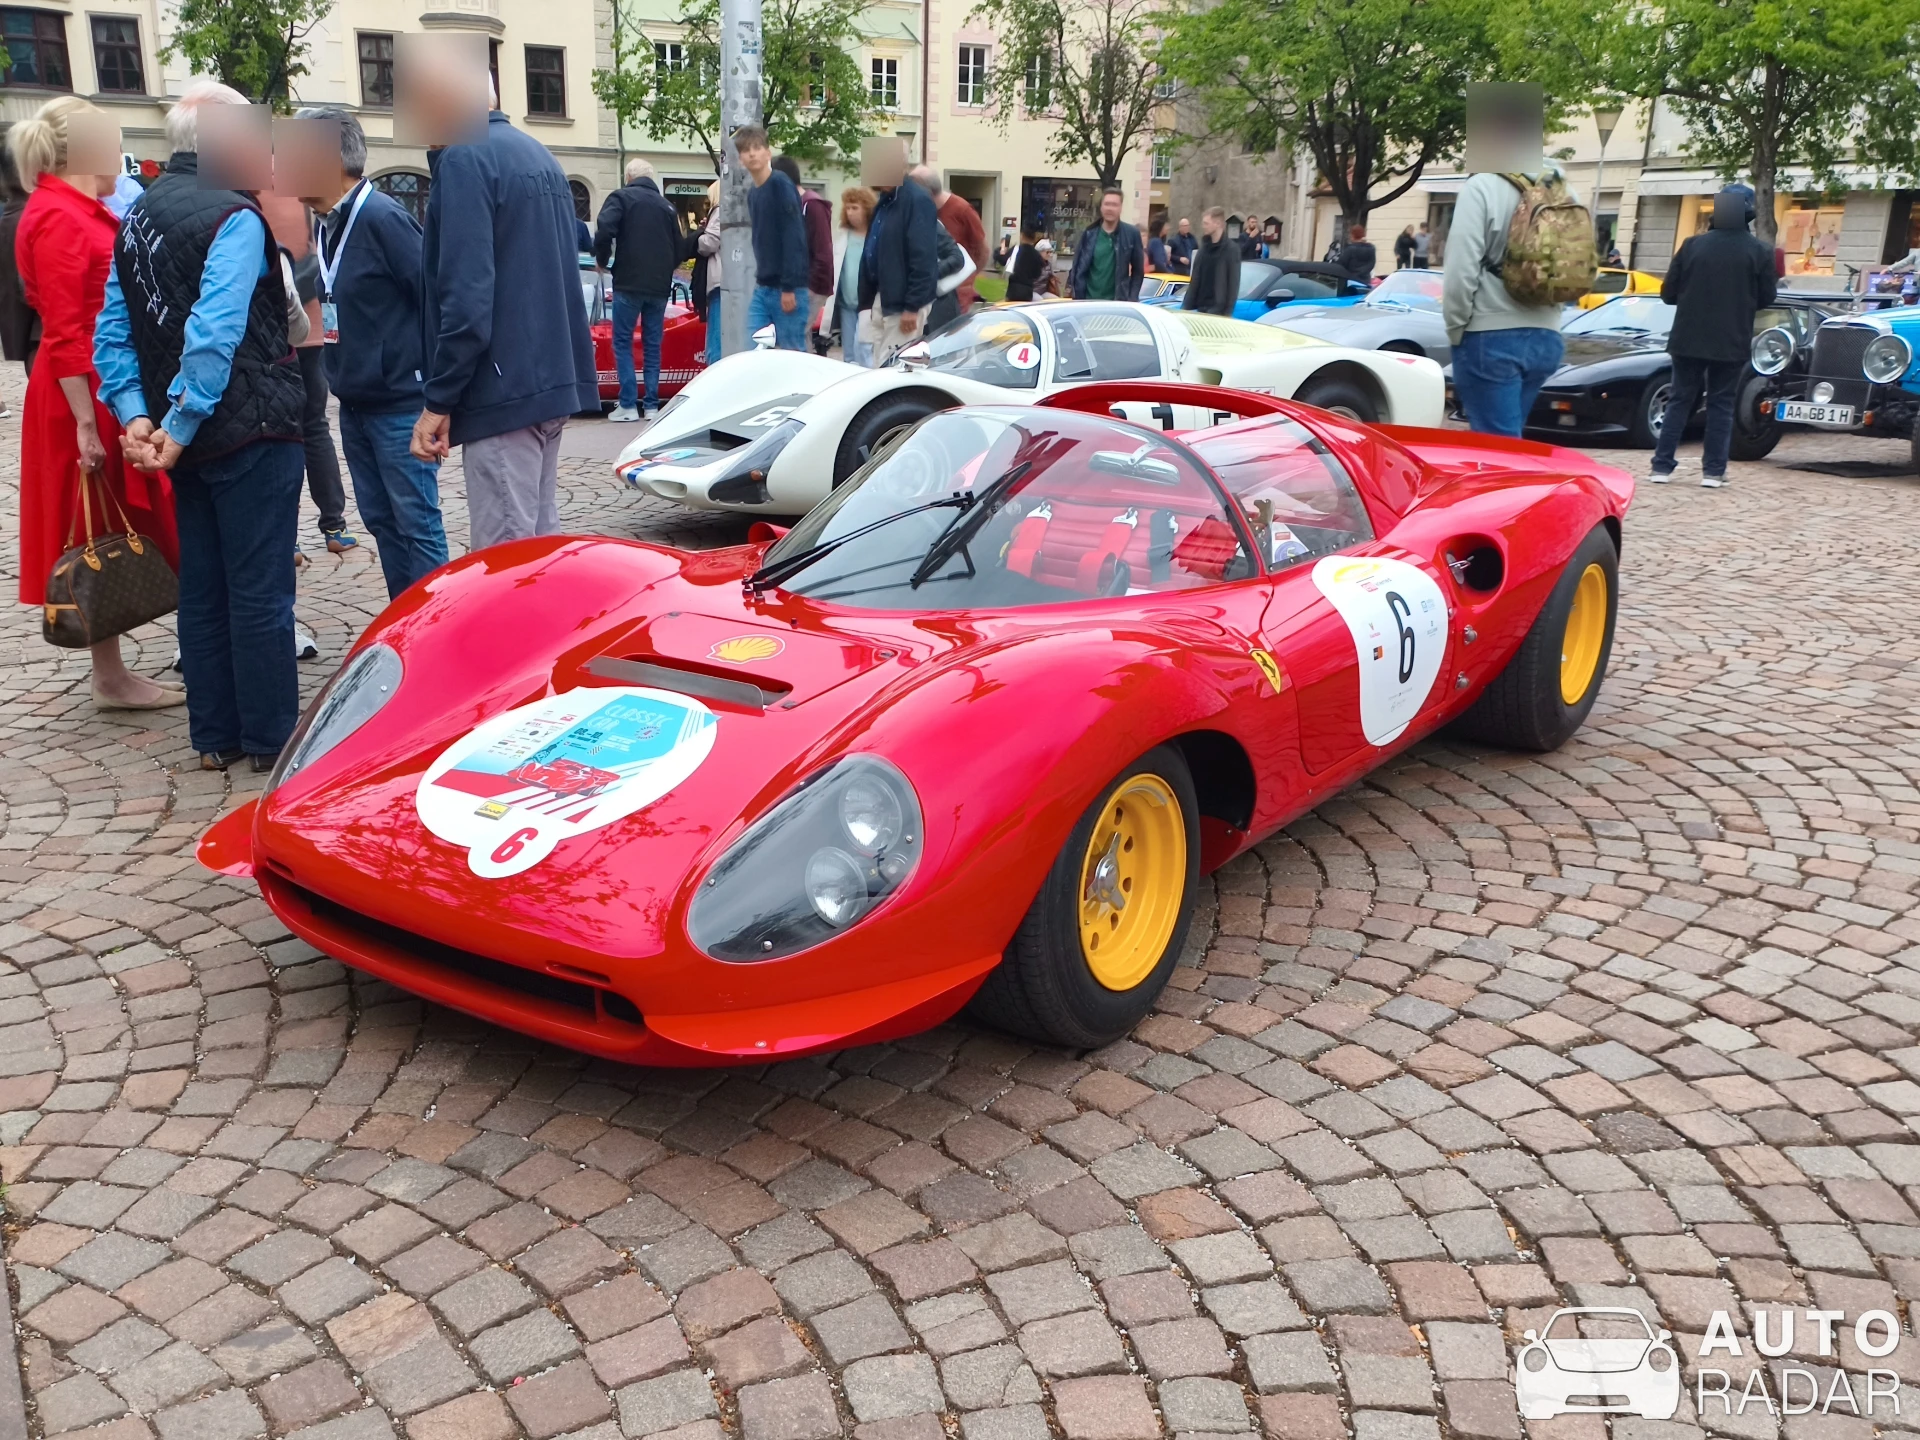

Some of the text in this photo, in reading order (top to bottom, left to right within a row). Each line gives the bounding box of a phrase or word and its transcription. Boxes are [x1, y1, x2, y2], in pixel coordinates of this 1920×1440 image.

[675, 184, 701, 194] globus
[1053, 206, 1085, 218] storey
[1018, 348, 1029, 363] 4
[1786, 405, 1849, 423] AA GB 1 H
[1385, 590, 1415, 684] 6
[587, 716, 620, 732] CAR
[604, 704, 674, 728] CLASSIC
[490, 827, 539, 863] 6
